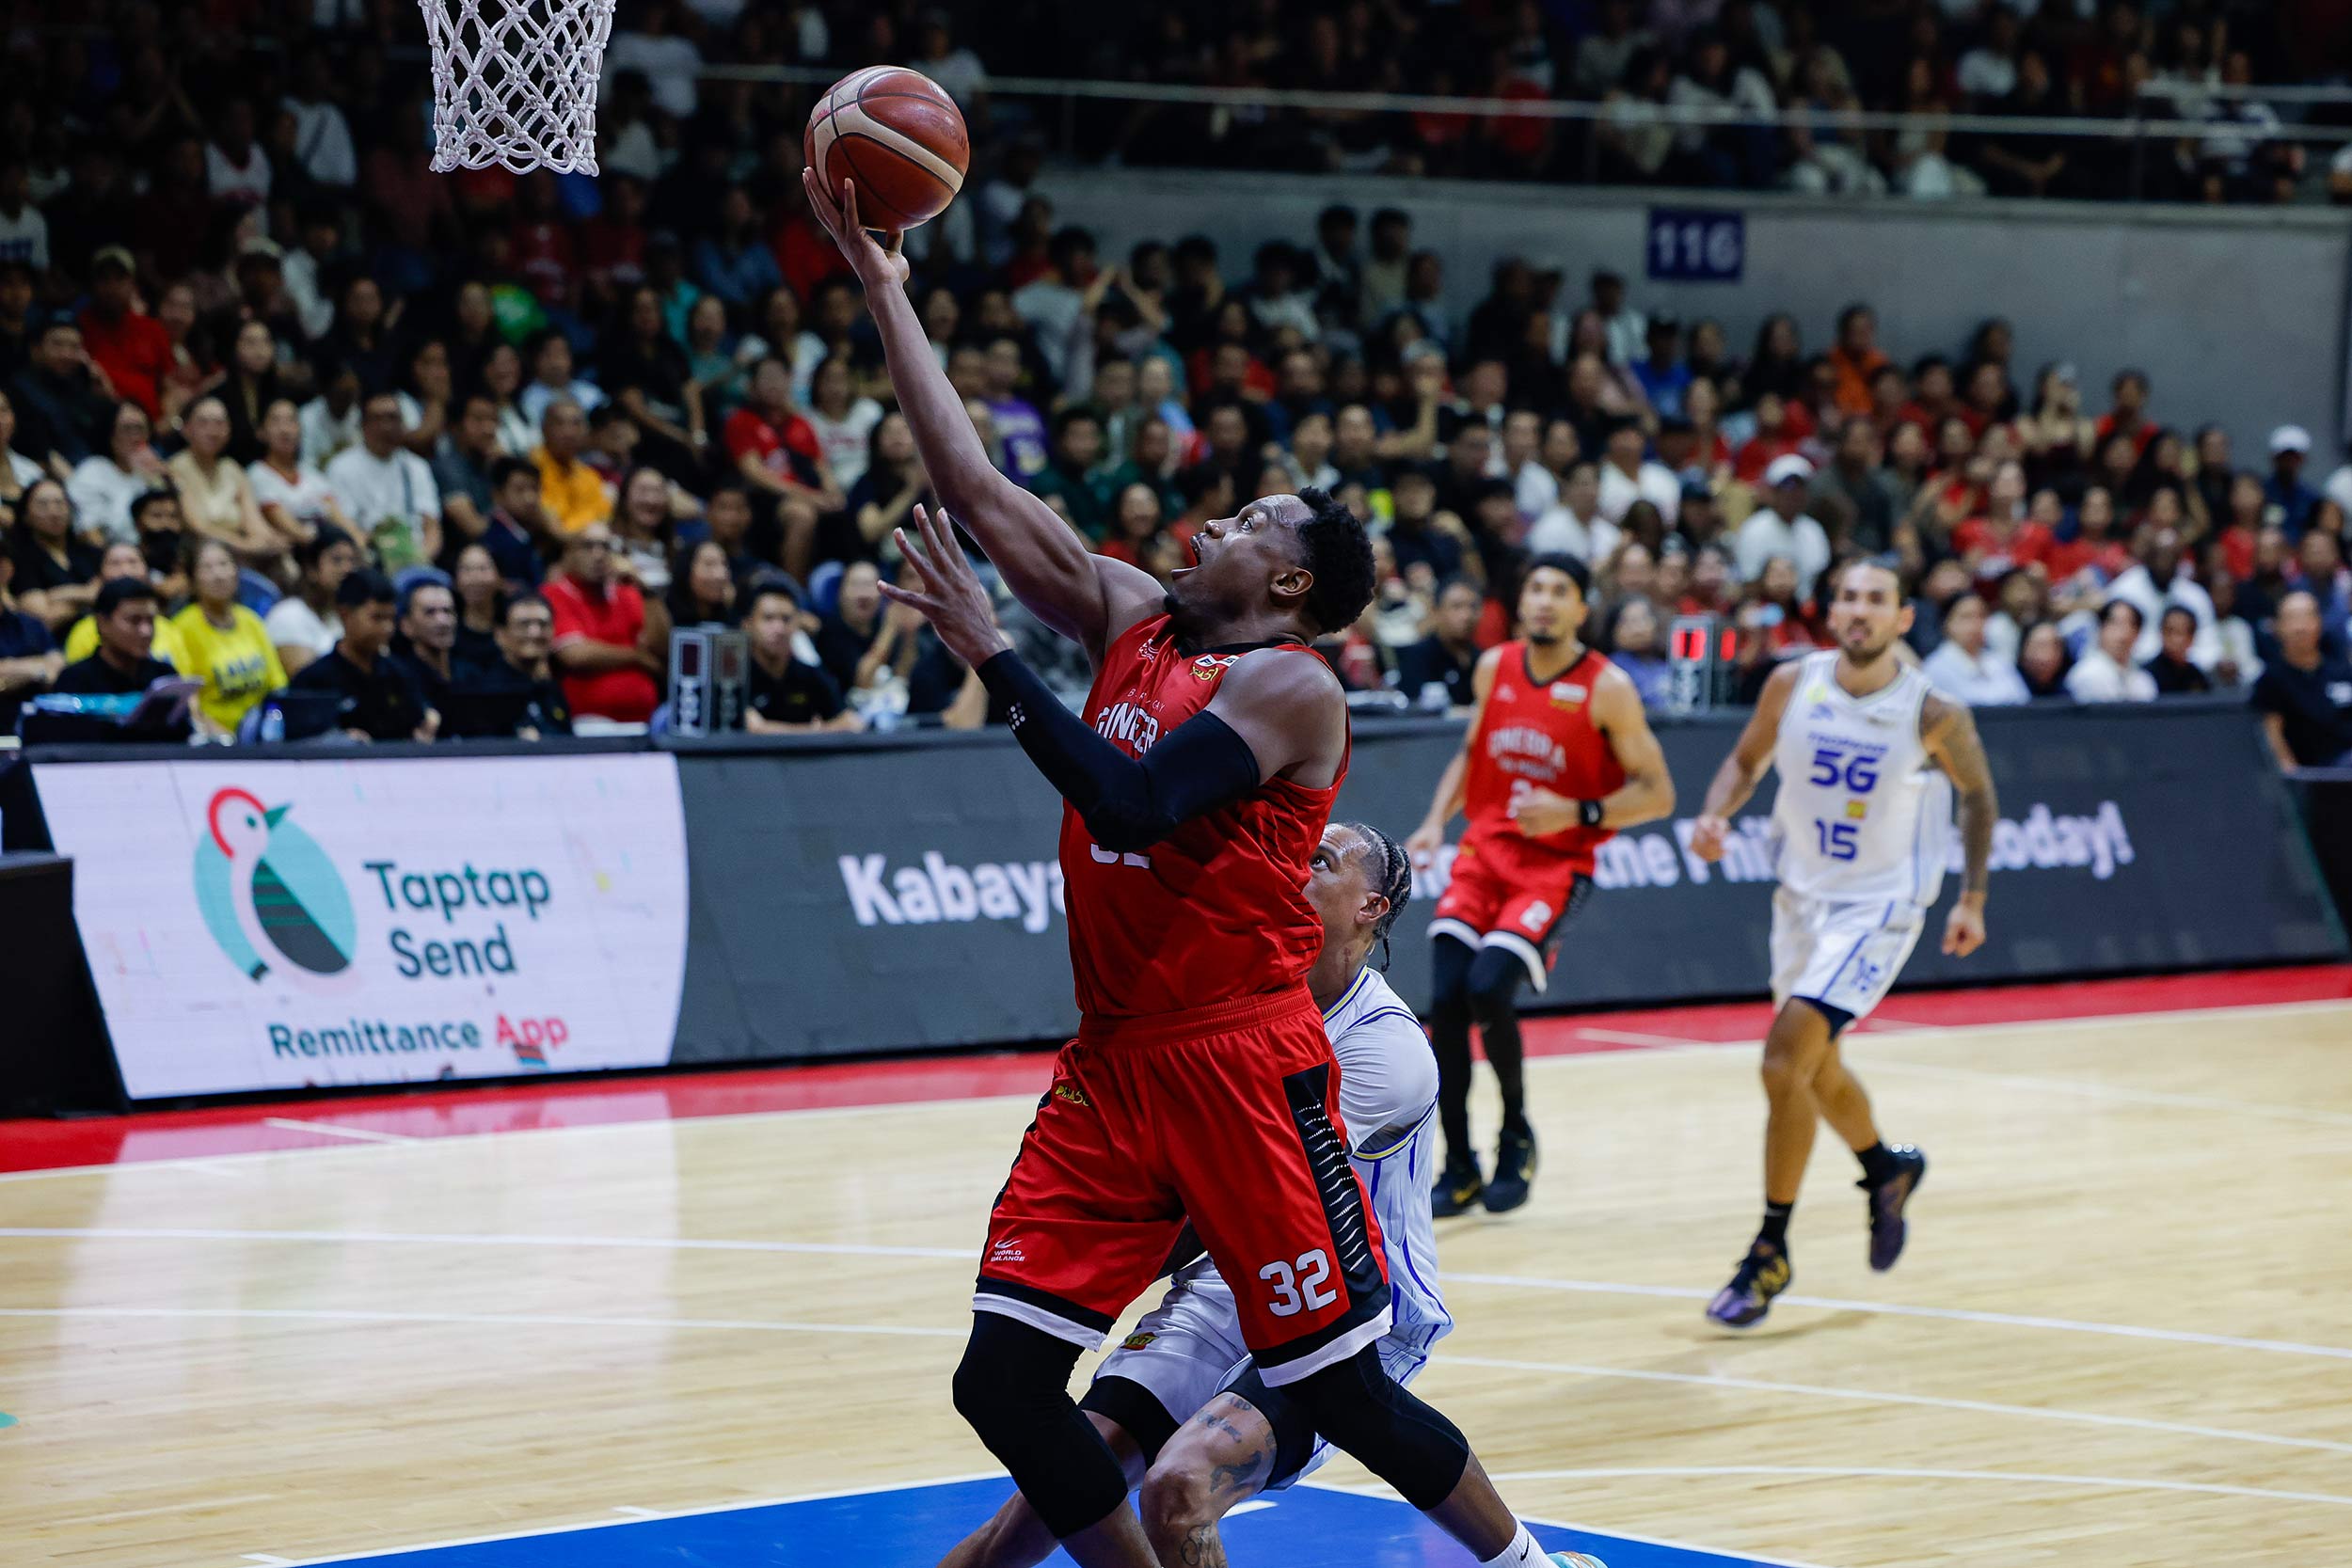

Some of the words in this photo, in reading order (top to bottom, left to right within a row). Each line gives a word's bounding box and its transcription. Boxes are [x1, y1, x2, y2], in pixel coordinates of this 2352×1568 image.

[1654, 221, 1740, 272] 116
[1809, 749, 1880, 794] 5G
[1815, 816, 1859, 862] 15
[1986, 801, 2136, 879] oday!
[363, 859, 550, 923] Taptap
[389, 922, 516, 979] Send
[266, 1017, 482, 1058] Remittance
[496, 1013, 568, 1051] App
[1259, 1247, 1338, 1317] 32
